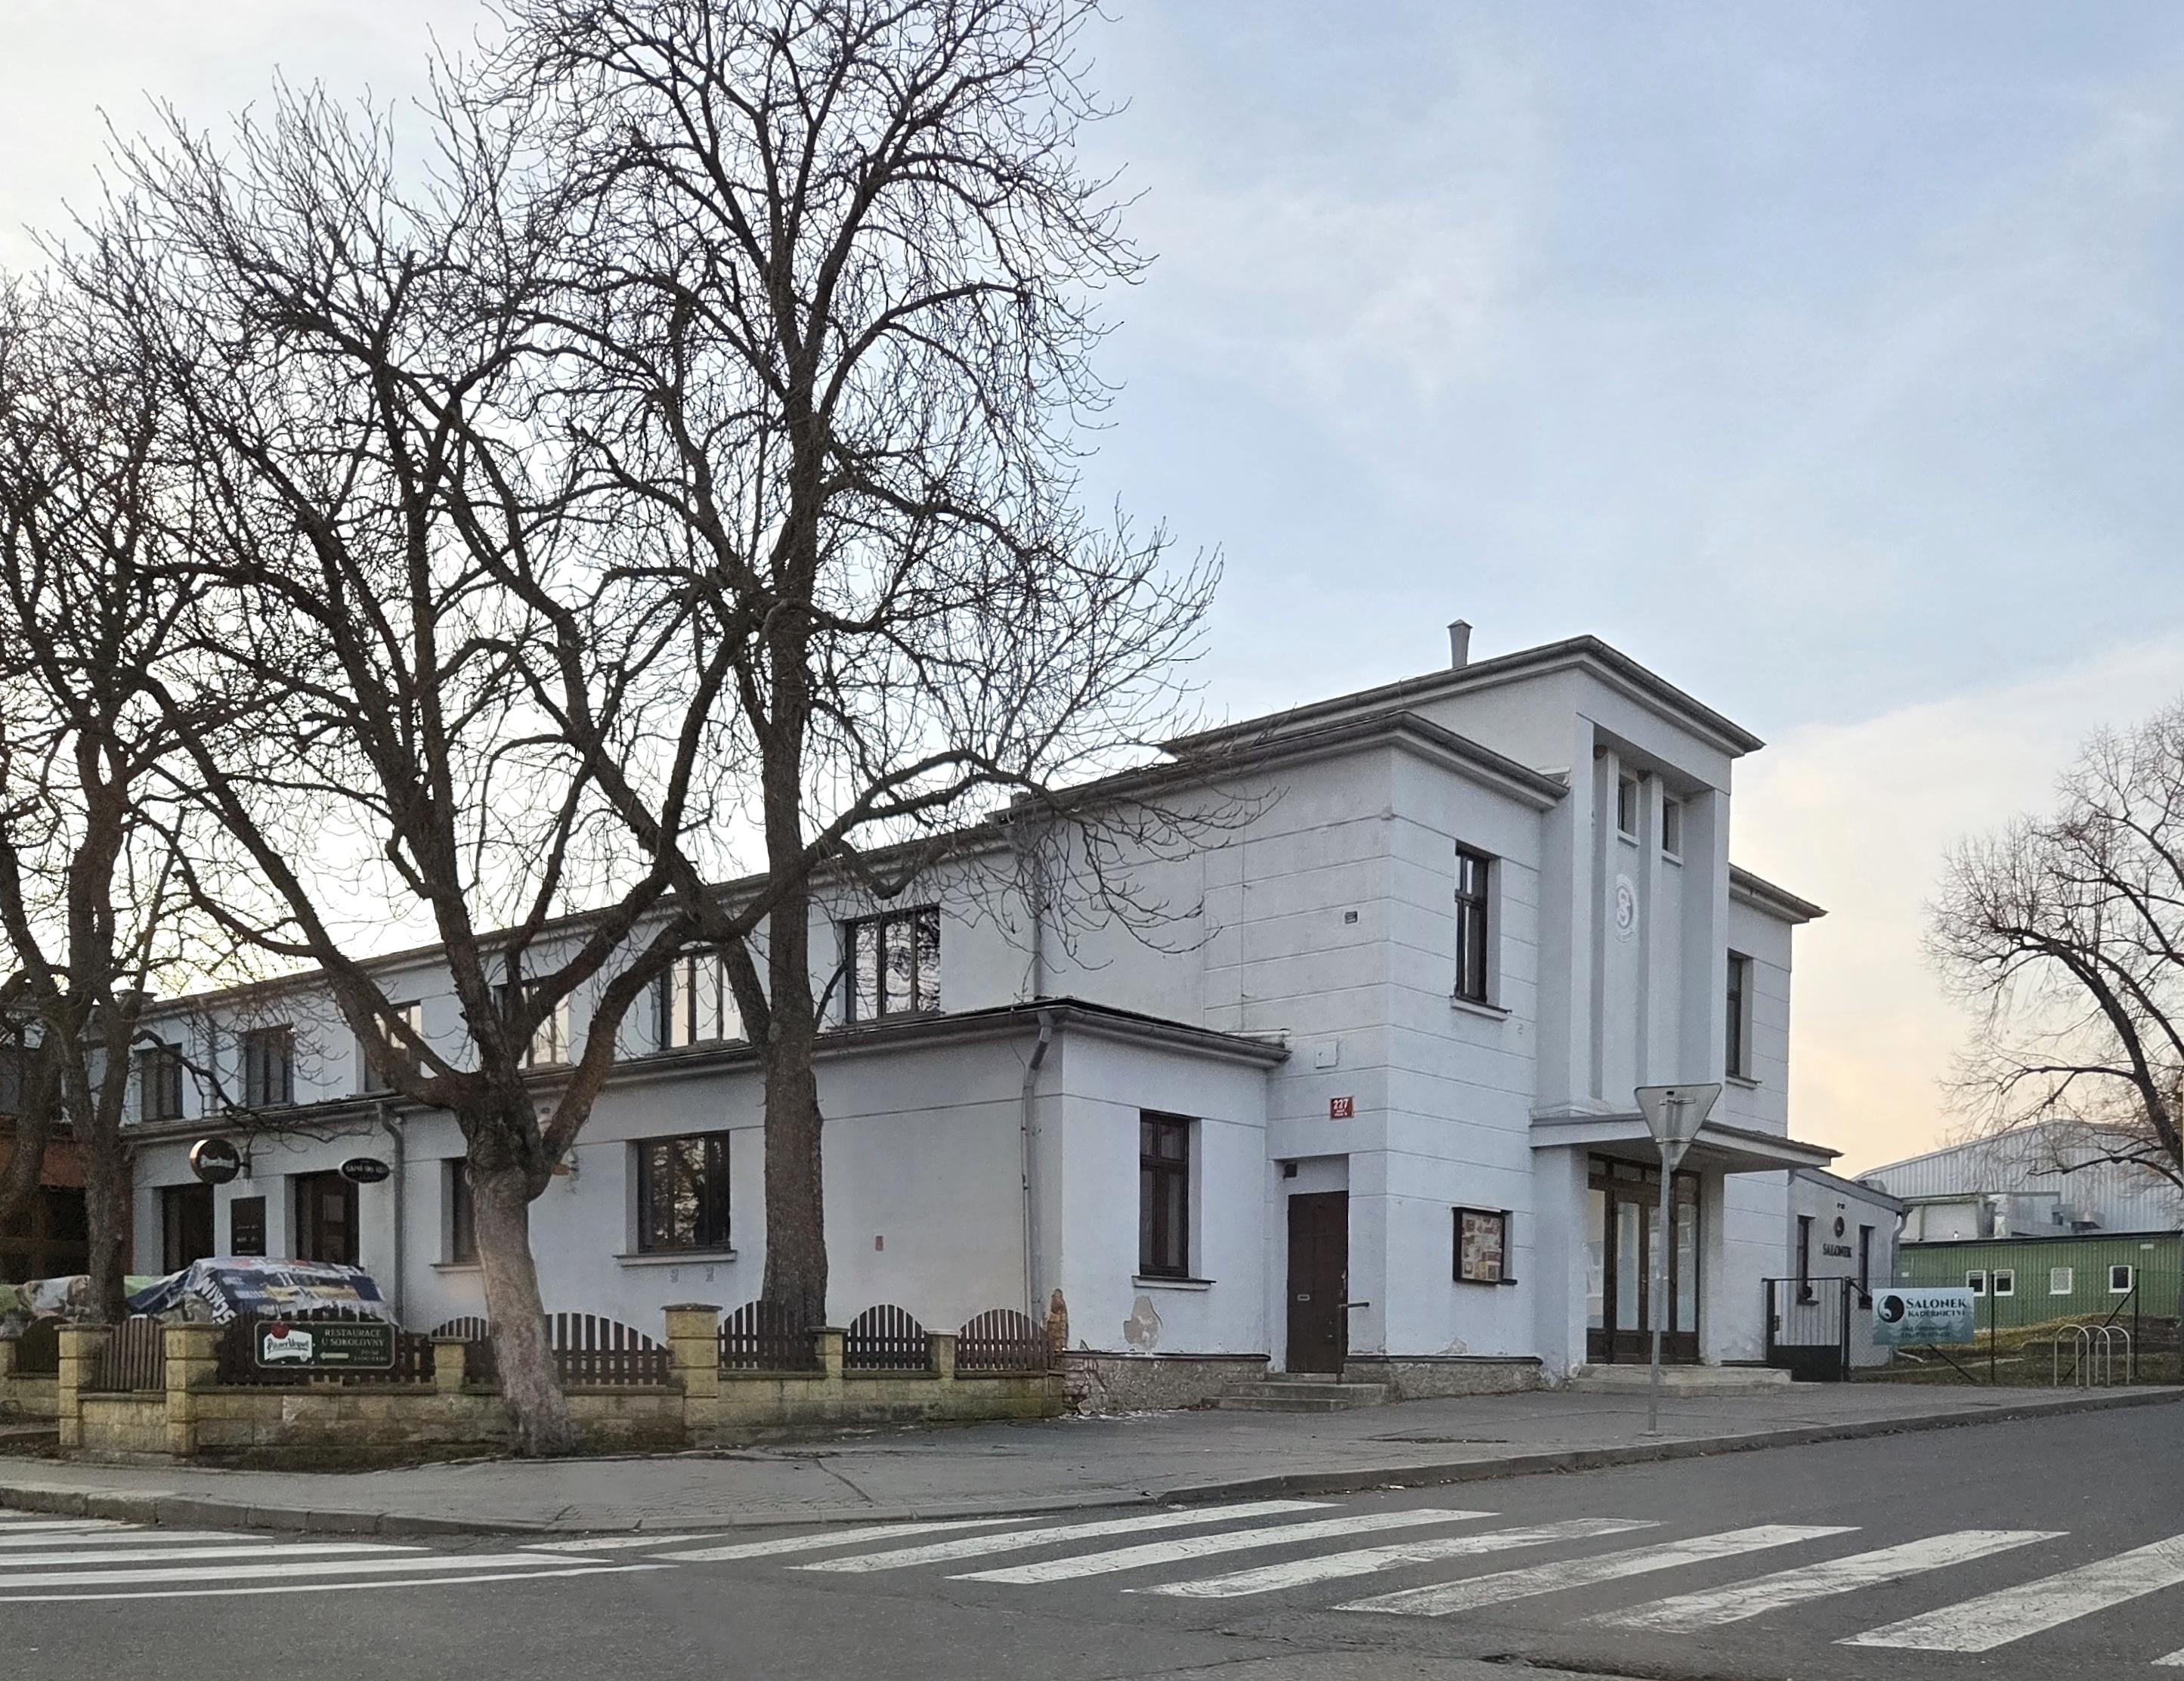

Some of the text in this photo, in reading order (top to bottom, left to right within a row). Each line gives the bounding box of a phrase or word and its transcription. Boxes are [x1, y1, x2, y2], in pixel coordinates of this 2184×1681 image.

[1333, 1098, 1349, 1110] 227
[1906, 1298, 1966, 1309] SALONEK
[324, 1328, 382, 1338] RESTAURACE
